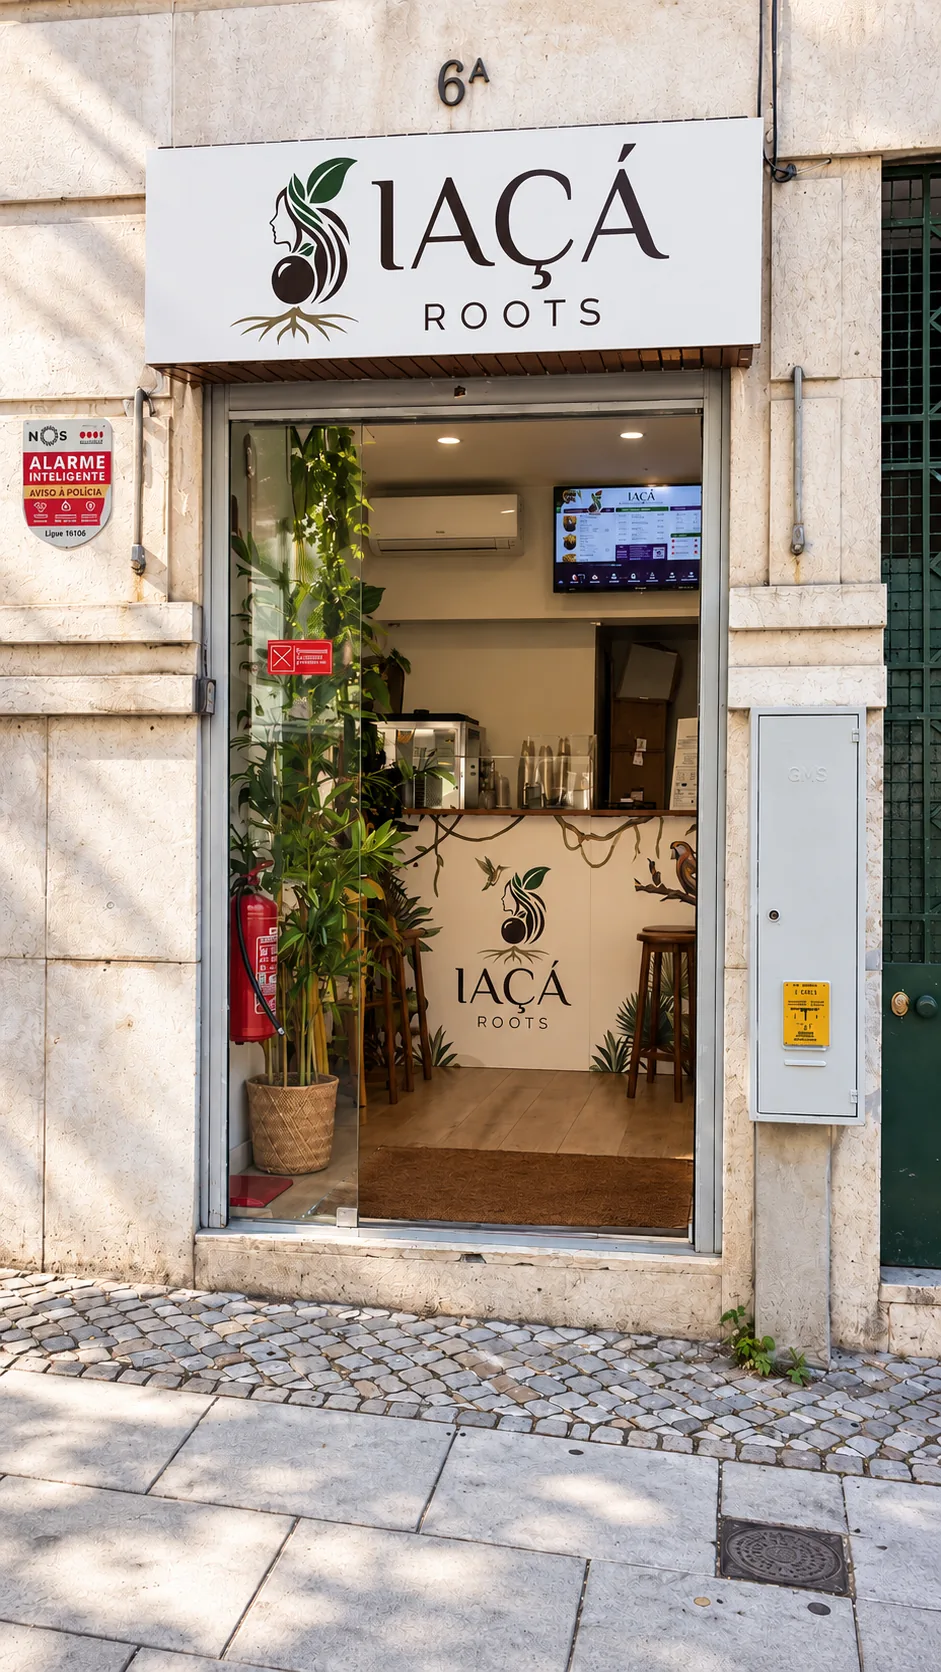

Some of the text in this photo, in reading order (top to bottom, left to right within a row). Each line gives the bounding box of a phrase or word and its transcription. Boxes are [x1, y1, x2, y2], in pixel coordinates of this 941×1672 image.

[371, 143, 669, 289] IAÇÁ
[424, 297, 601, 331] ROOTS
[28, 424, 68, 446] NOS
[29, 455, 105, 470] ALARME
[29, 471, 105, 482] INTELIGENTE
[29, 488, 57, 498] AVISO
[66, 486, 102, 497] POLÍCIA
[45, 529, 64, 539] Ligue
[455, 960, 572, 1014] IAÇÁ
[477, 1016, 549, 1030] ROOTS
